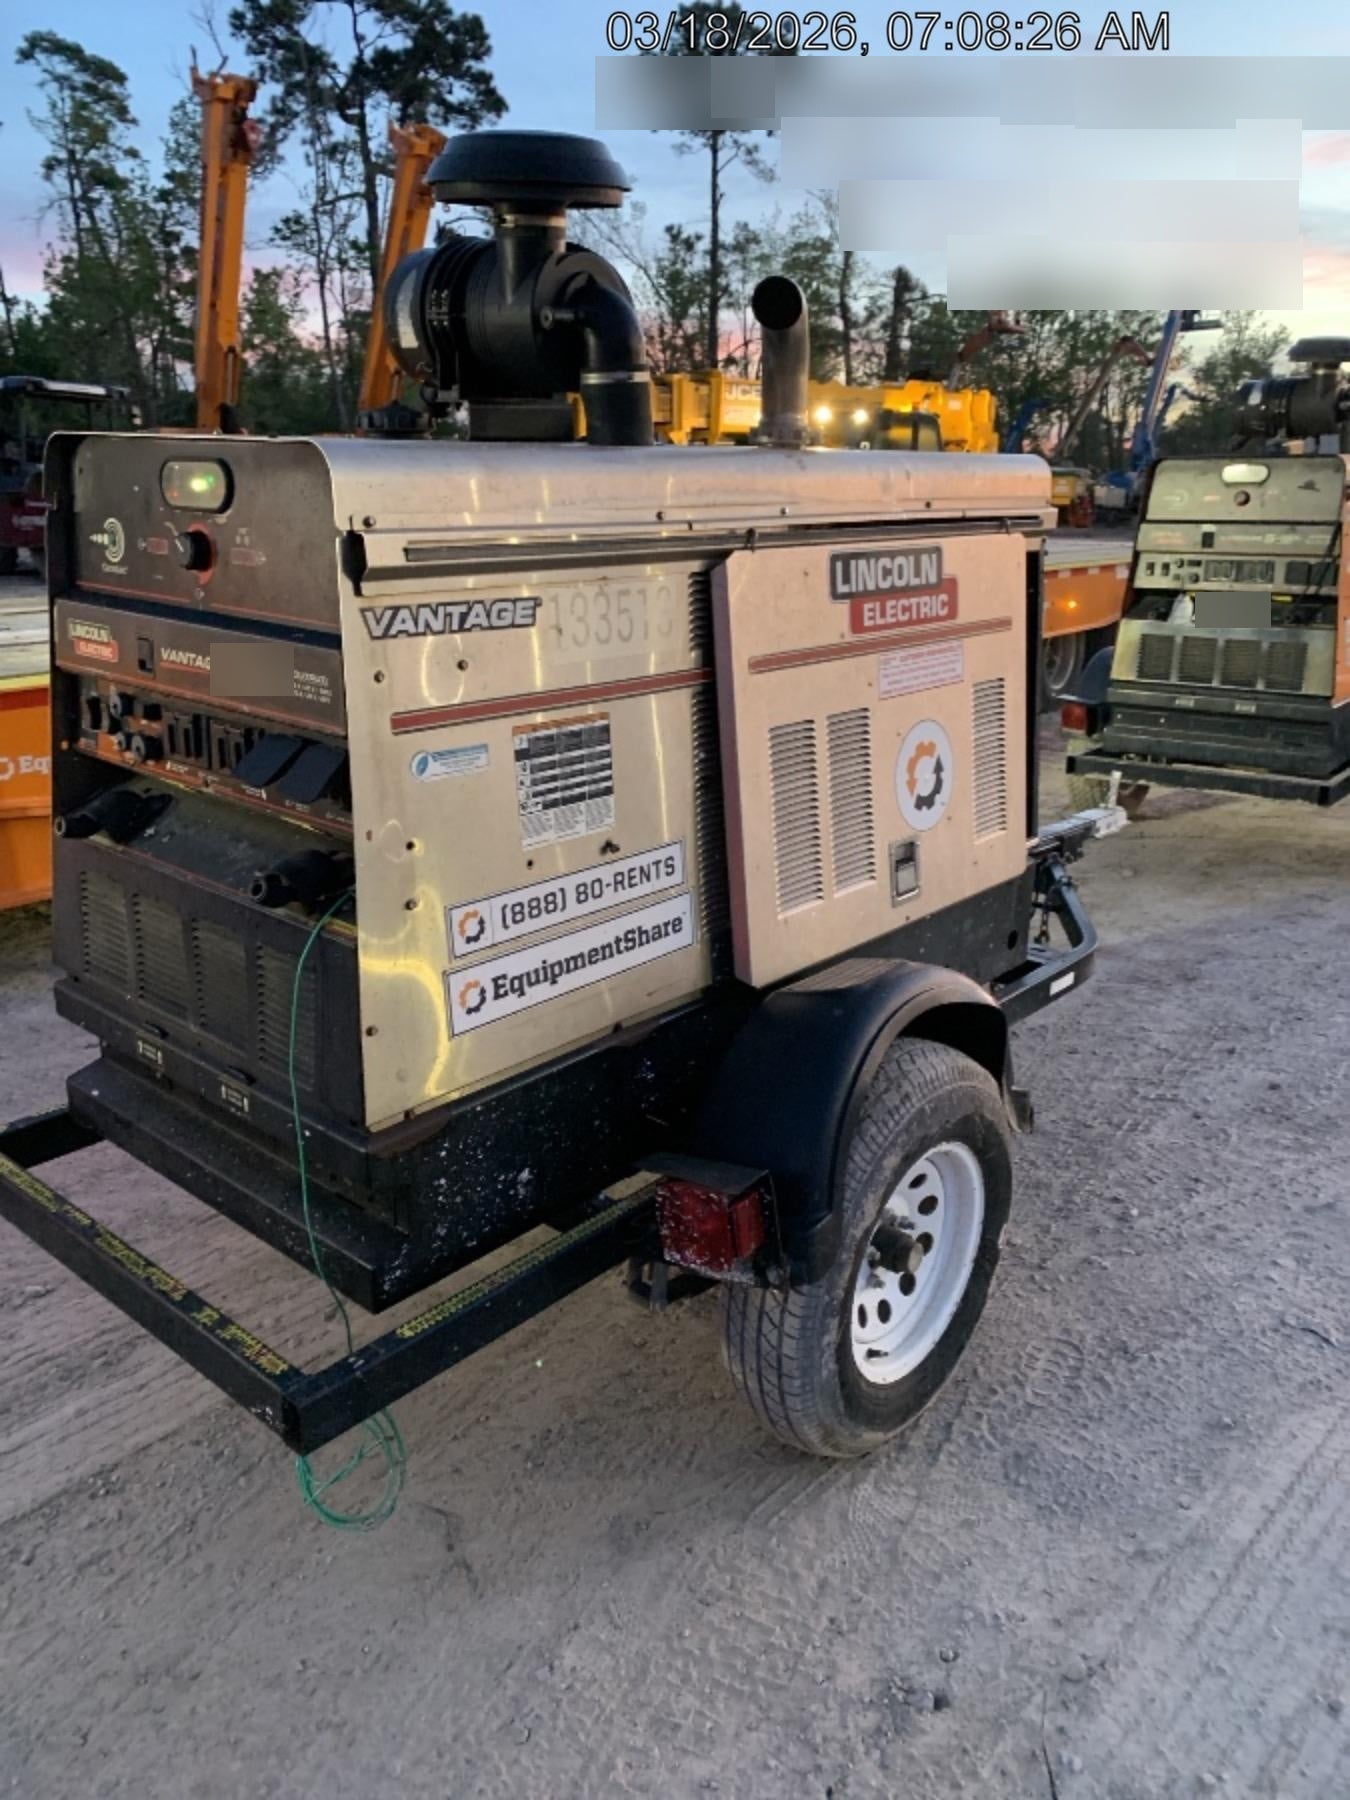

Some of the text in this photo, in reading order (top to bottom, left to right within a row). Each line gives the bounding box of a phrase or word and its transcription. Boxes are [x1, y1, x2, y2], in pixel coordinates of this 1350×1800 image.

[835, 553, 938, 594] LINCOLN
[361, 598, 540, 639] VANTAGE
[549, 585, 674, 650] 133513
[862, 593, 949, 627] ELECTRIC
[161, 647, 210, 670] VANTAG
[18, 755, 52, 775] Eq
[500, 856, 676, 930] (888) 80-RENTS
[491, 914, 683, 1001] EquipmentShare
